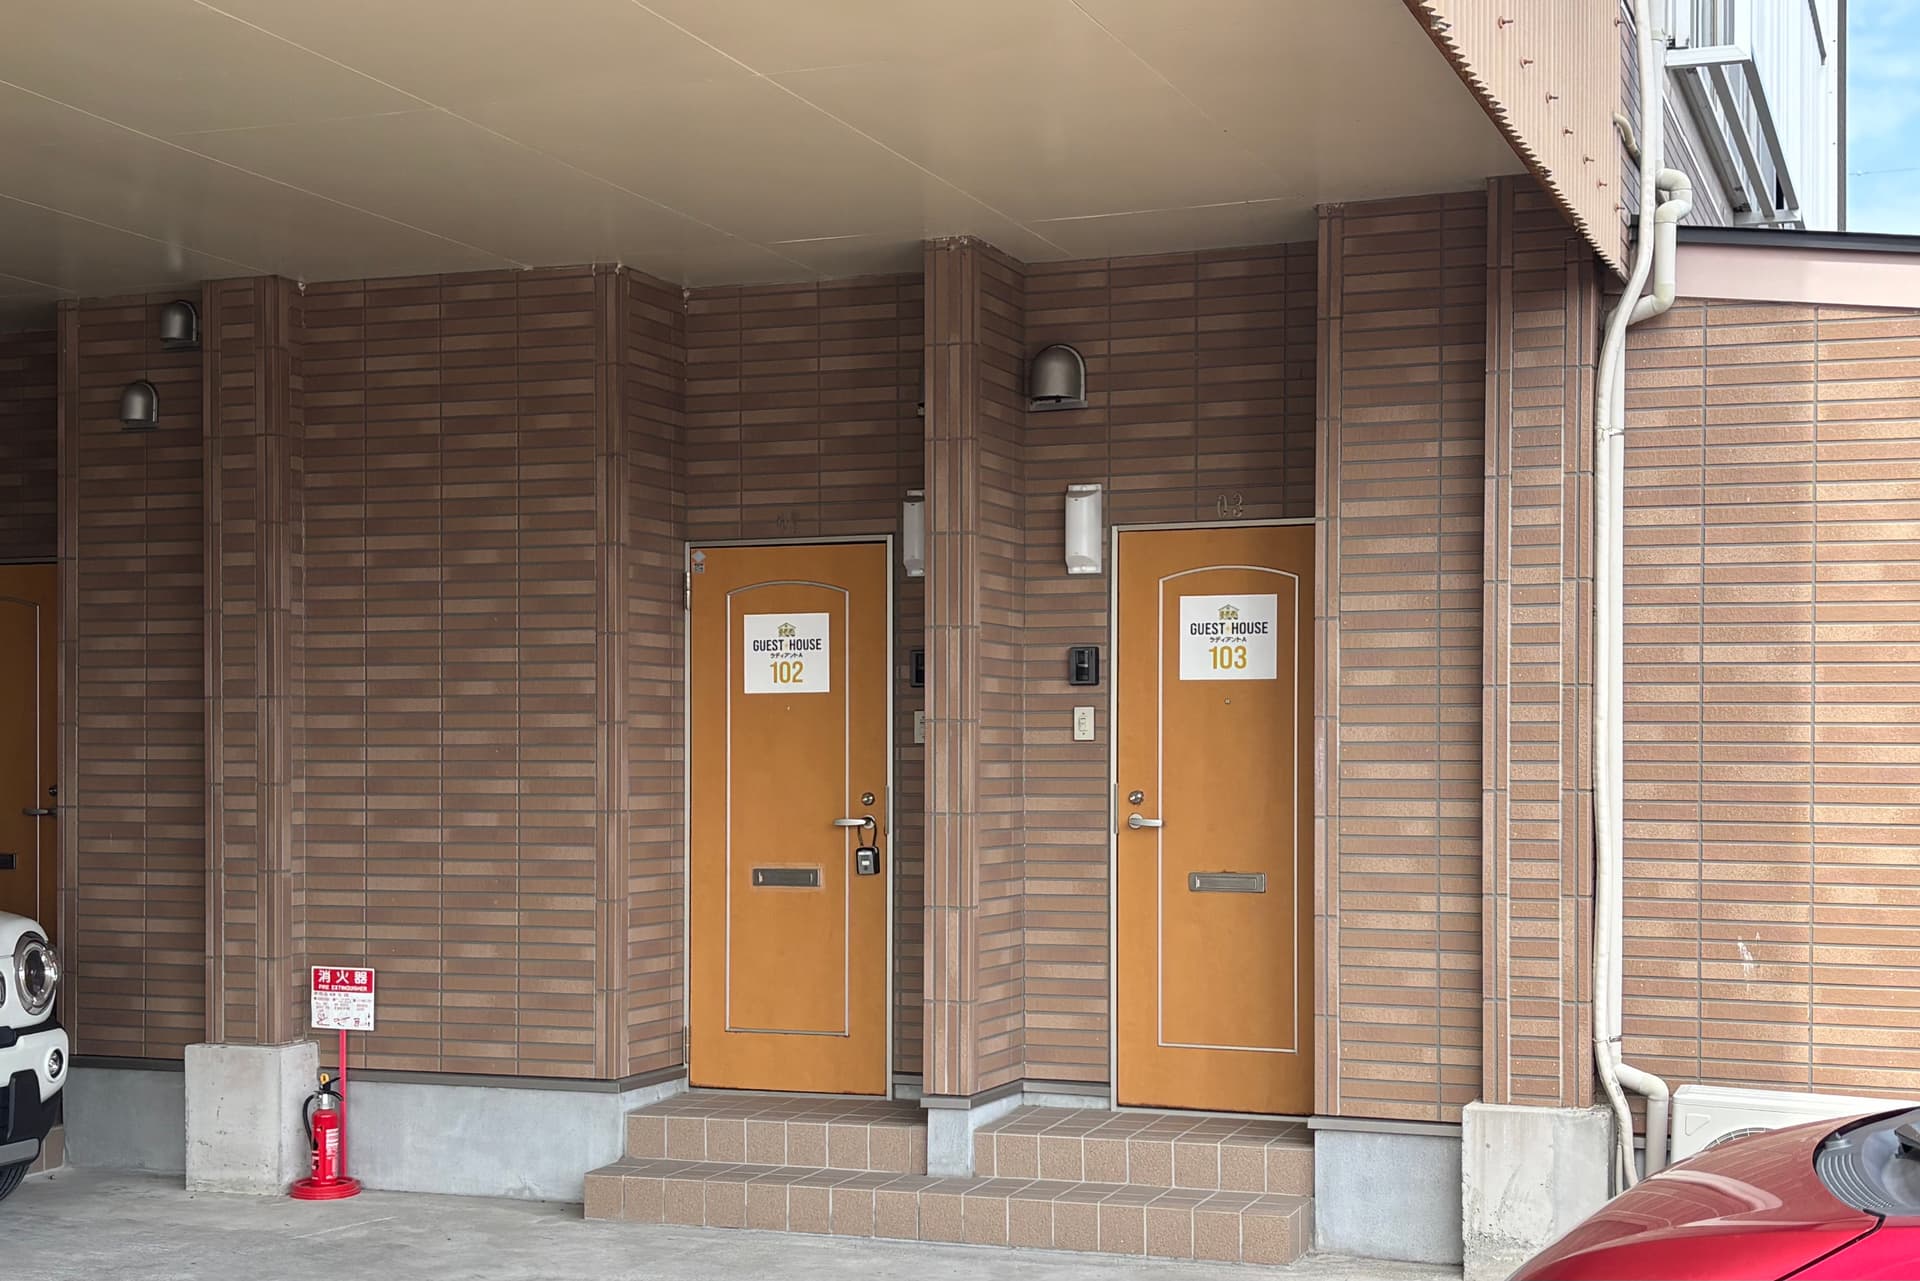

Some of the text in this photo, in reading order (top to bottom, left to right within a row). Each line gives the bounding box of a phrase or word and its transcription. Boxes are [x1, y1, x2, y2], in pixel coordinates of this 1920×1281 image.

[1190, 621, 1269, 636] GUEST HOUSE
[753, 638, 822, 652] GUEST HOUSE
[1208, 645, 1247, 670] 103
[770, 660, 804, 684] 102
[318, 969, 368, 985] 消火器
